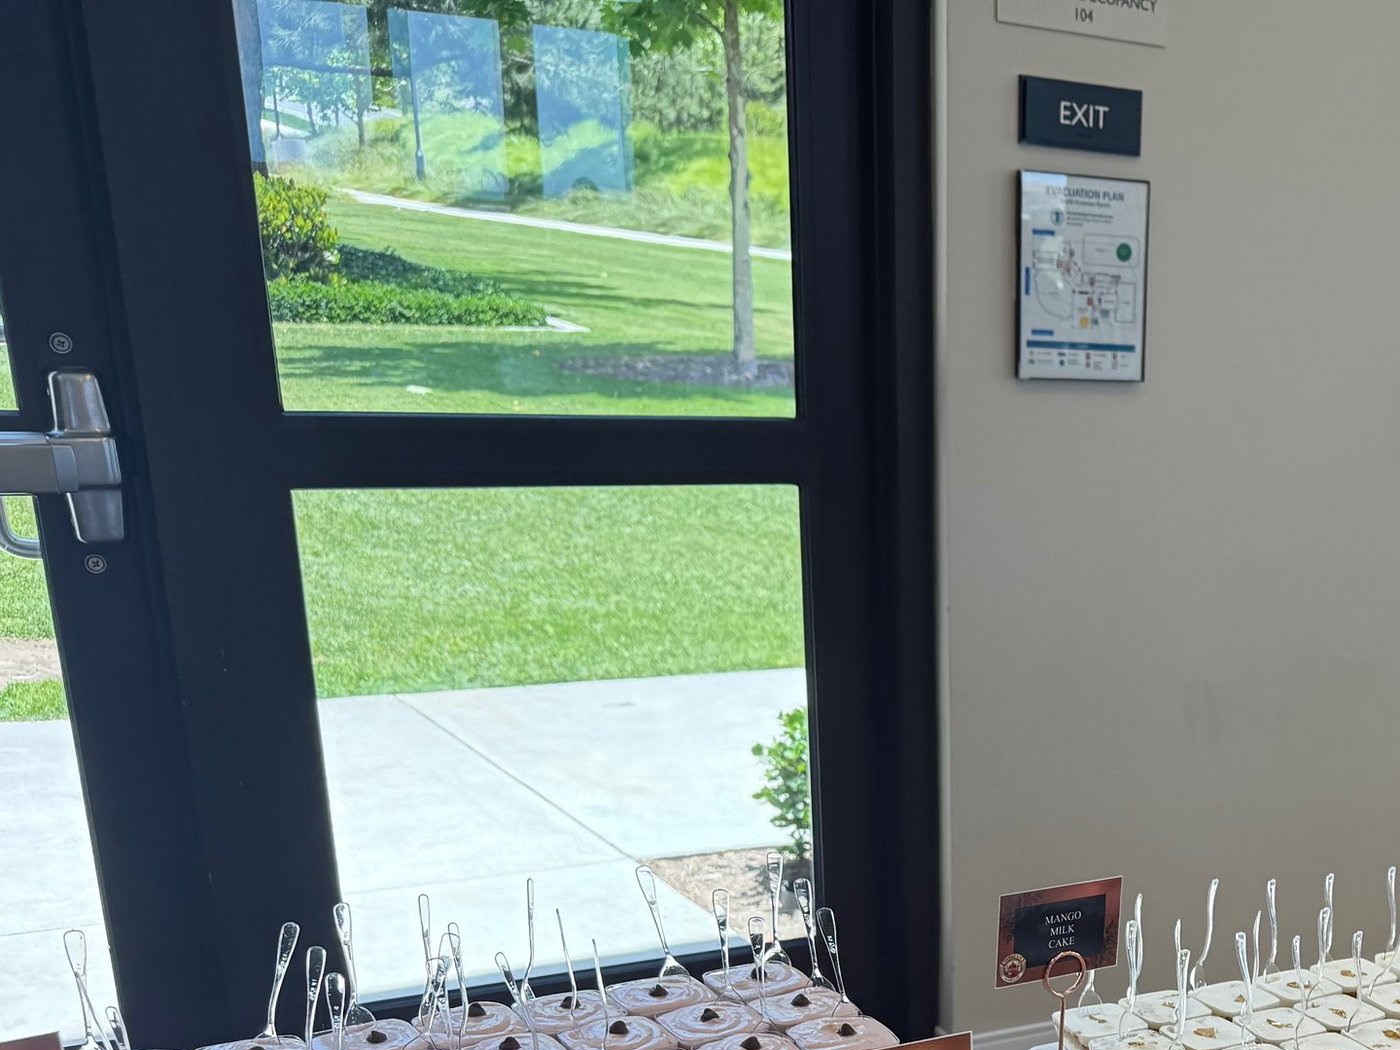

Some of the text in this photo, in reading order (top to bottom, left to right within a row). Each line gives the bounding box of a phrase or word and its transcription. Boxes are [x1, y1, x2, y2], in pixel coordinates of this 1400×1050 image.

[1080, 0, 1158, 13] UPANCY
[1075, 7, 1093, 23] 104
[1060, 100, 1109, 130] EXIT
[1046, 185, 1126, 202] EVCUATION PLAN
[1045, 910, 1082, 925] MANGO
[1050, 924, 1075, 936] MILK
[1048, 936, 1075, 949] CAKE
